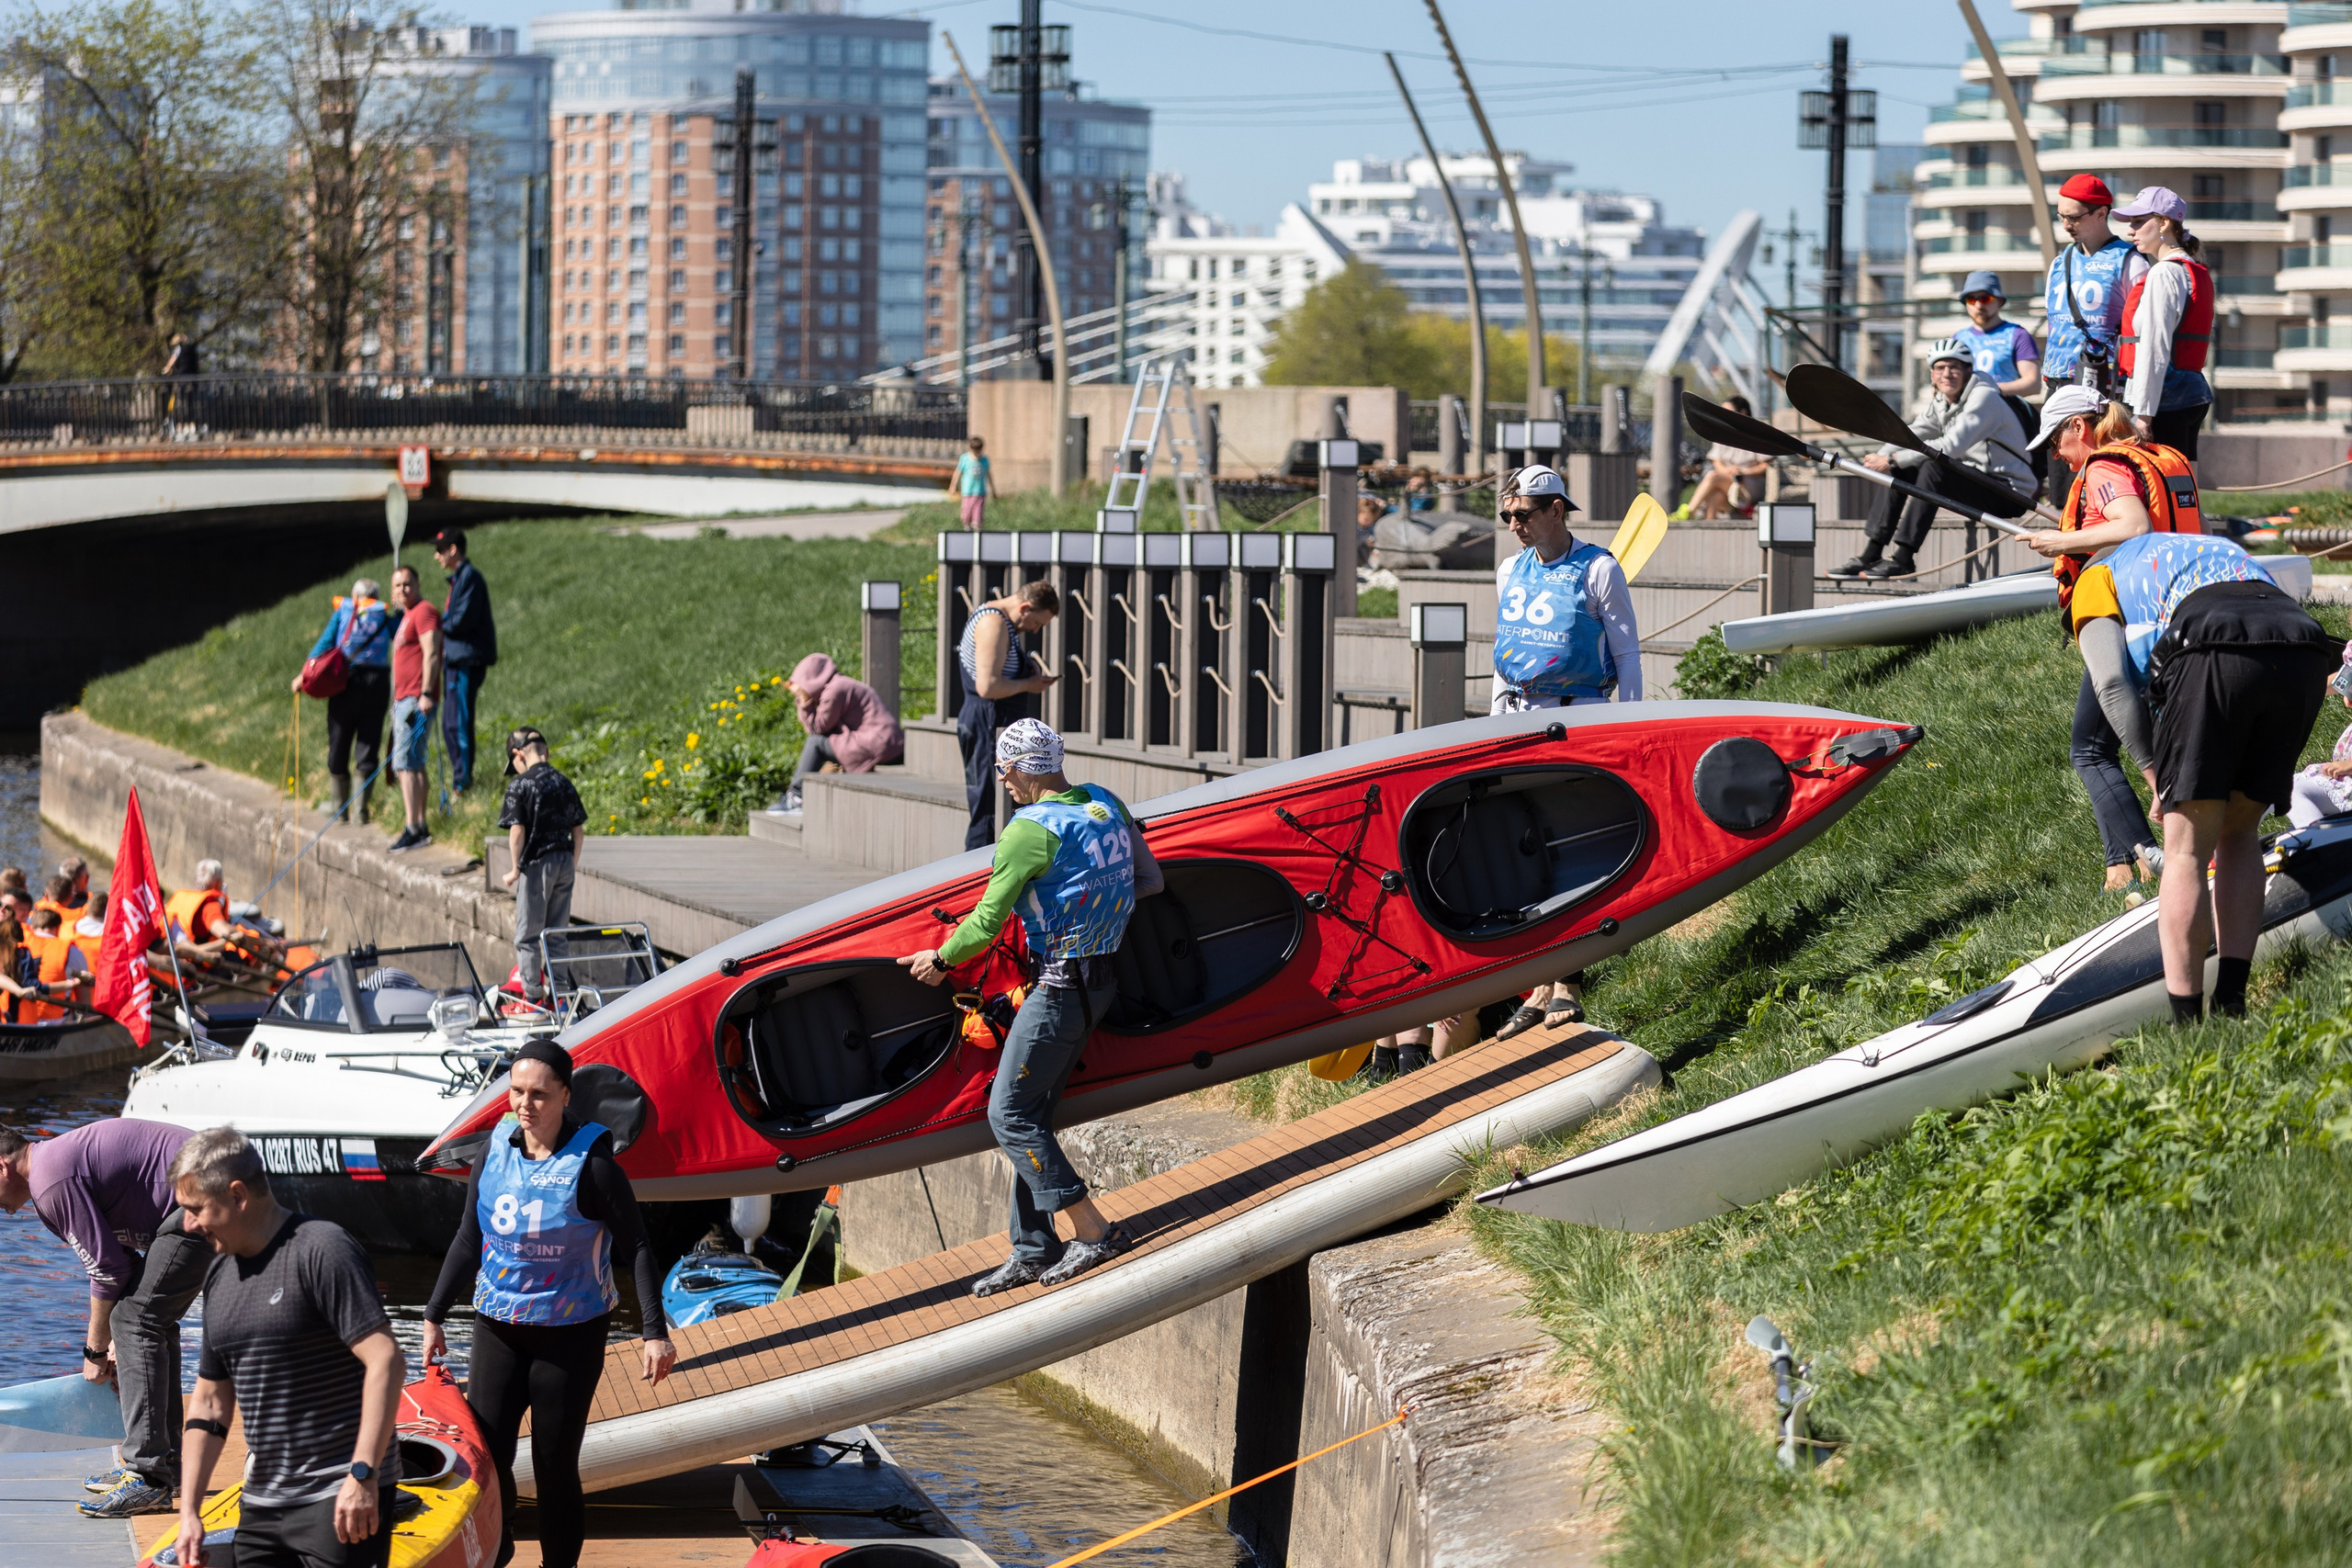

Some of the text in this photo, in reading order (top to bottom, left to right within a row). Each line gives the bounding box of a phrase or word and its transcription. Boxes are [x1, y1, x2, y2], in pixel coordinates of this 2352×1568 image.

[1501, 586, 1555, 626] 36
[1497, 625, 1570, 643] ATERPOINT
[1086, 829, 1131, 869] 129
[266, 1138, 293, 1174] 0287
[293, 1138, 322, 1174] RUS
[322, 1138, 340, 1174] 47
[530, 1172, 572, 1186] CANOE
[491, 1193, 543, 1239] 81
